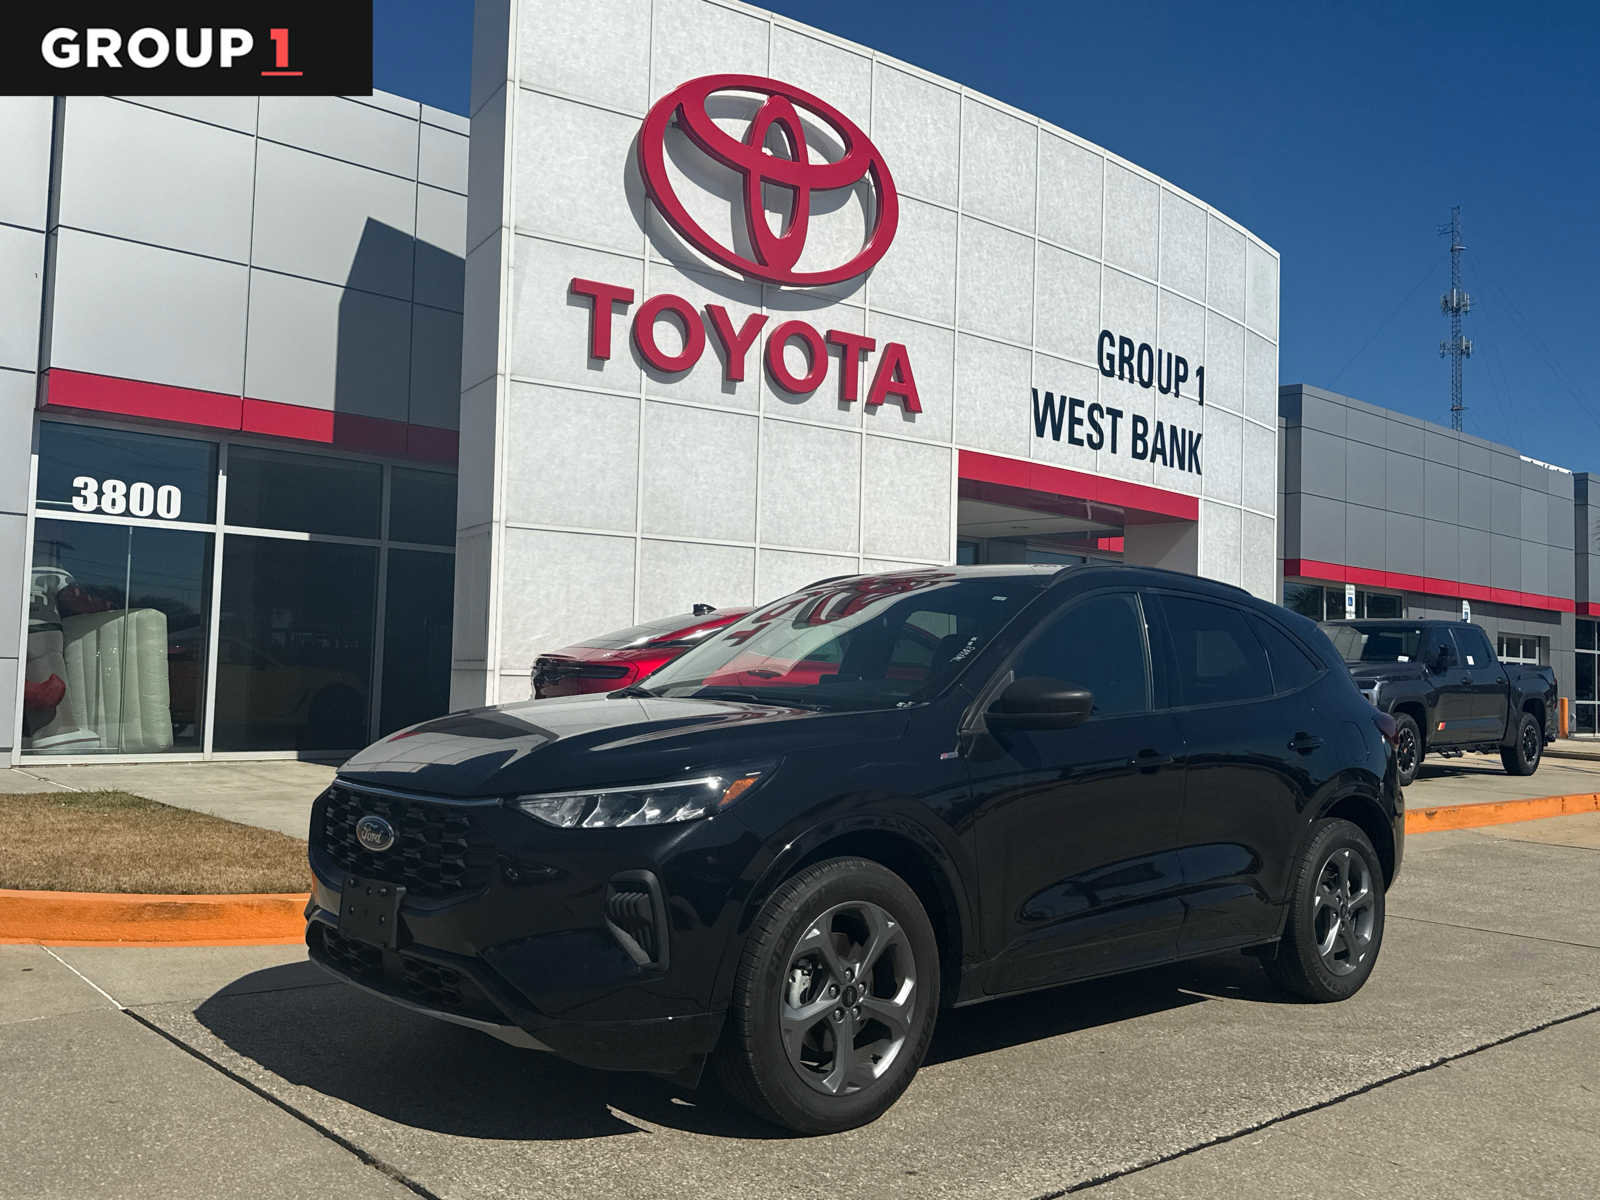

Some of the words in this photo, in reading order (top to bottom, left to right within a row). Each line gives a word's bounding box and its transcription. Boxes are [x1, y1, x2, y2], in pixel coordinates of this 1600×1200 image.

[571, 277, 922, 413] TOYOTA
[1097, 329, 1189, 399] GROUP
[1195, 365, 1205, 406] 1
[1031, 387, 1124, 454] WEST
[1131, 413, 1203, 475] BANK
[71, 476, 182, 519] 3800
